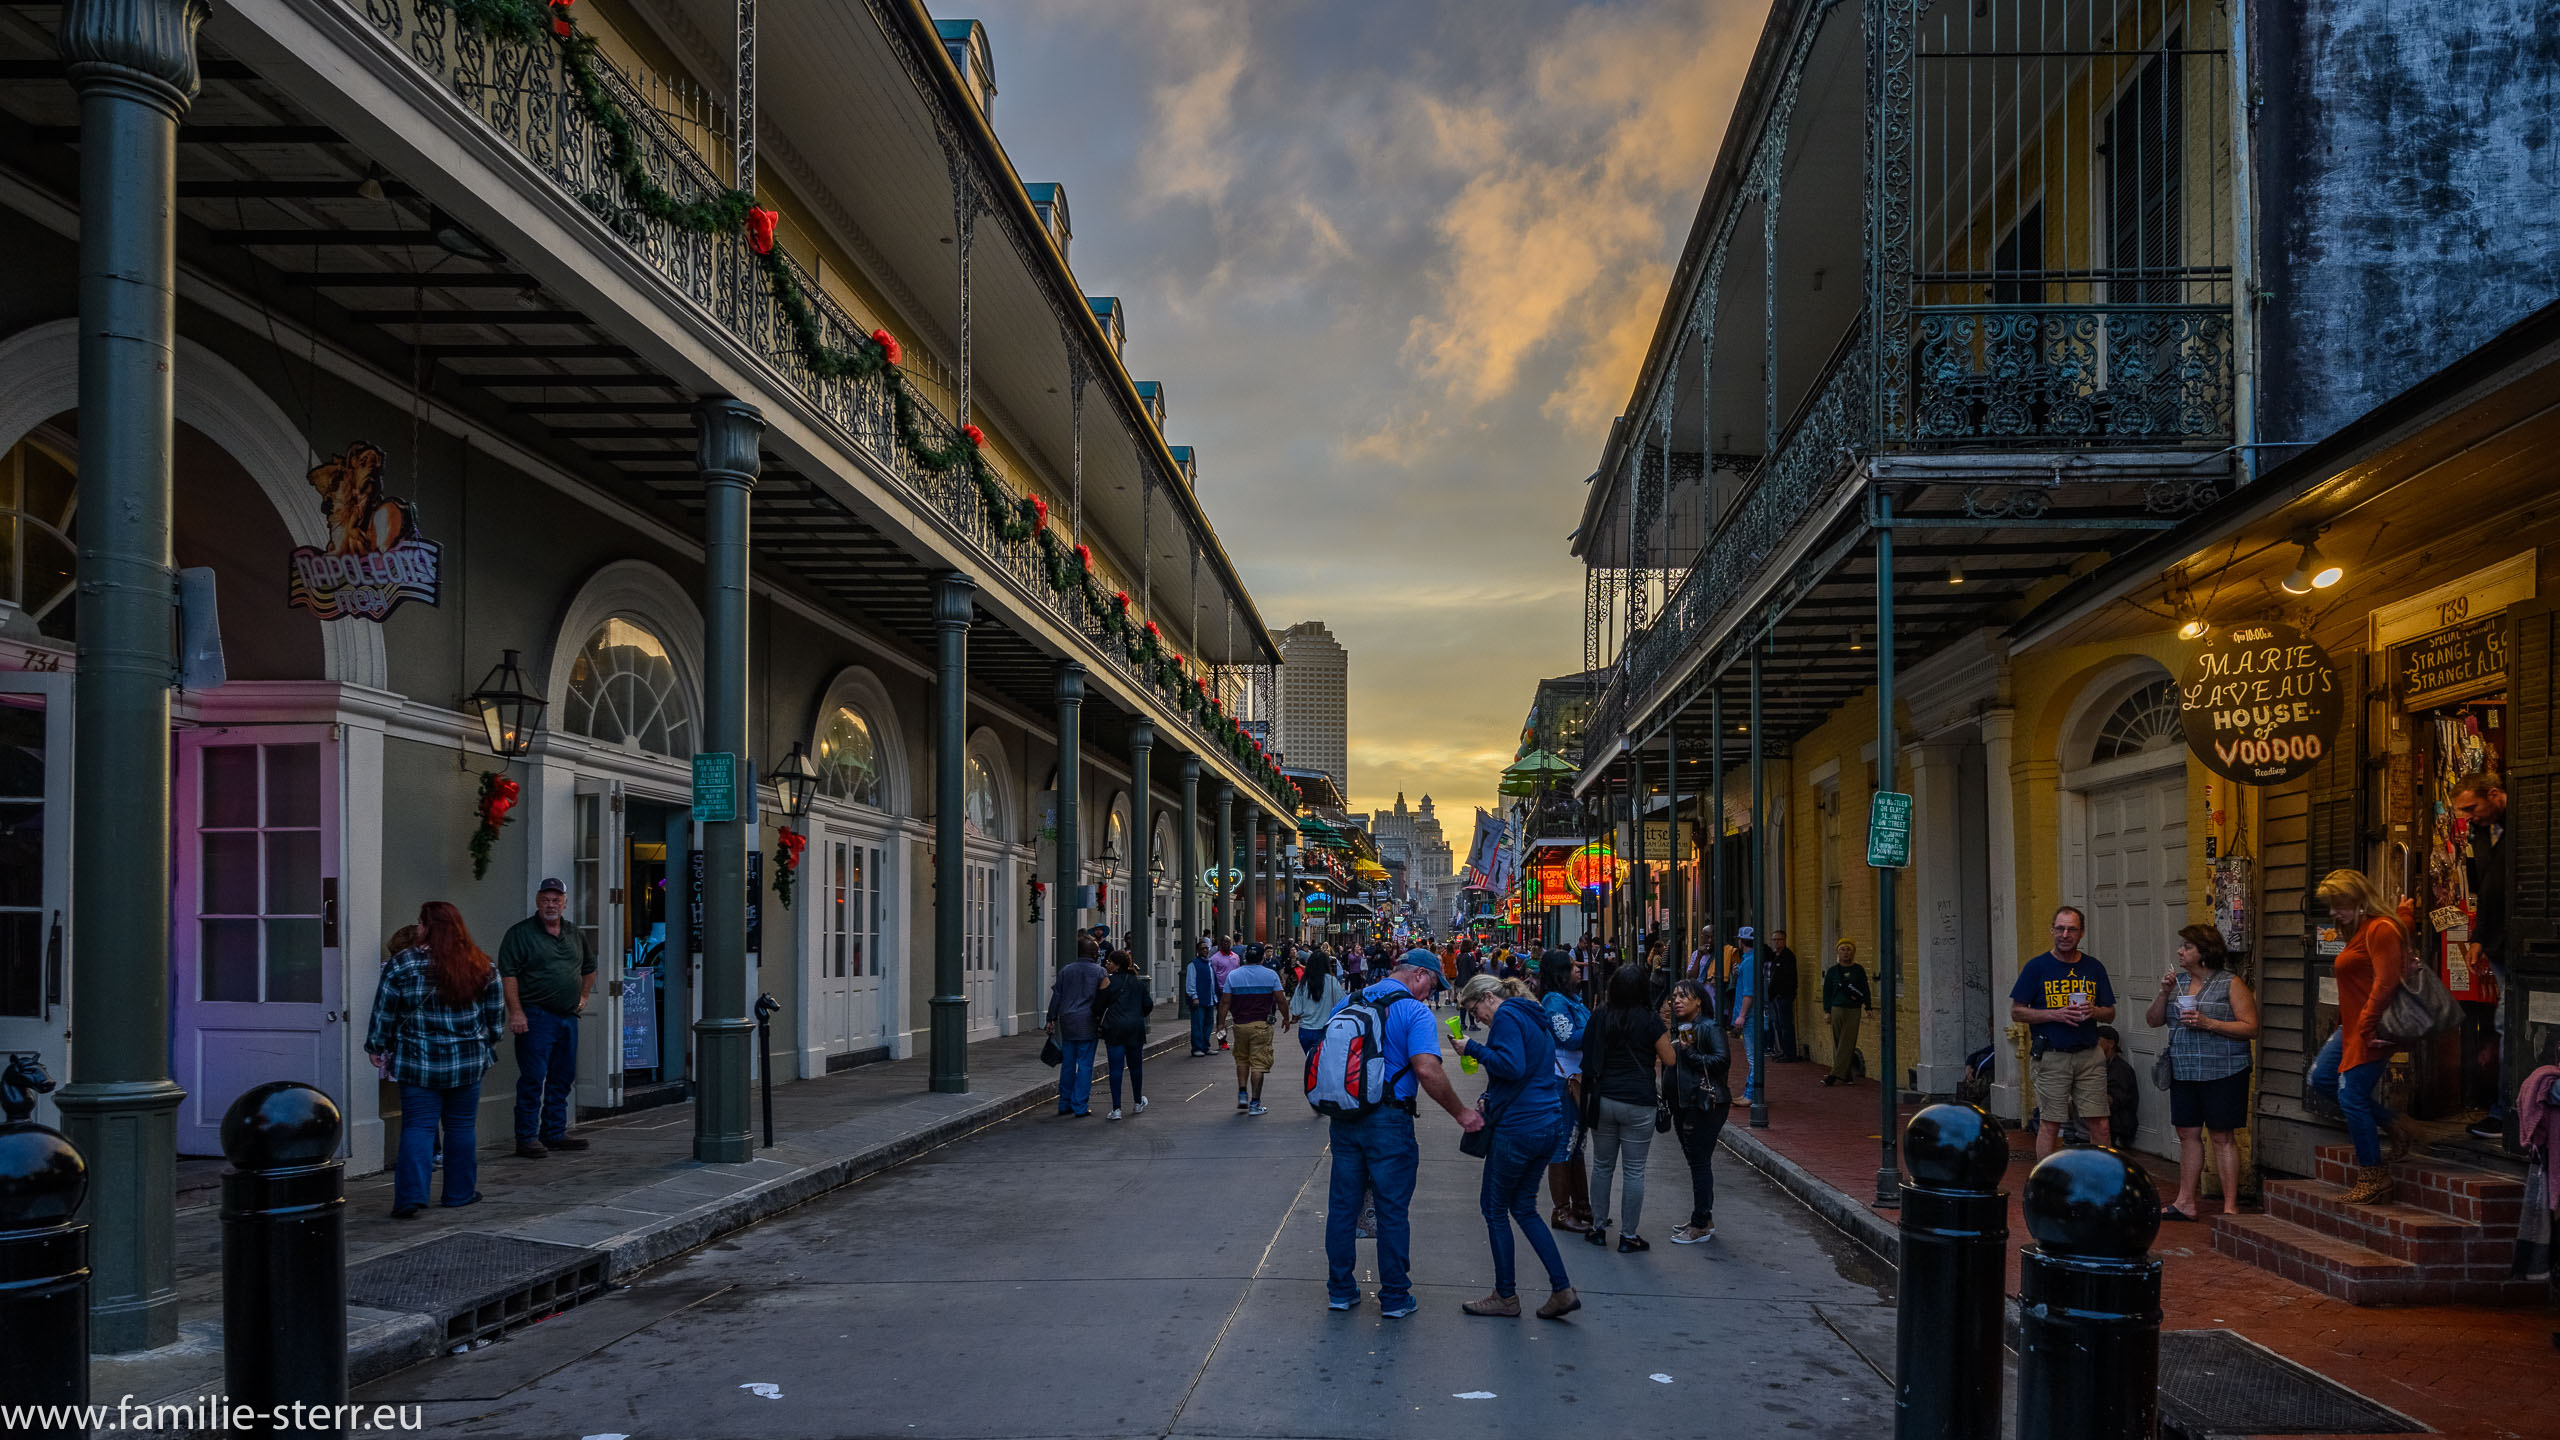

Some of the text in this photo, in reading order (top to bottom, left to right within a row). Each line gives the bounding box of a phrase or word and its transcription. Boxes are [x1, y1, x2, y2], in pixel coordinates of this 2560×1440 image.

[335, 588, 388, 613] ITCH
[2436, 596, 2468, 626] 739
[2429, 630, 2461, 648] SPECIAL
[24, 649, 59, 672] 734
[2199, 645, 2317, 682] MARIE
[2402, 641, 2472, 675] STRANGE
[2408, 648, 2508, 694] STRANGE ALT
[2182, 667, 2332, 711] LAVEAU'S
[2213, 702, 2309, 730] HOUSE
[2253, 721, 2279, 741] of
[2215, 734, 2322, 768] VOODOO
[2049, 995, 2058, 1007] IS
